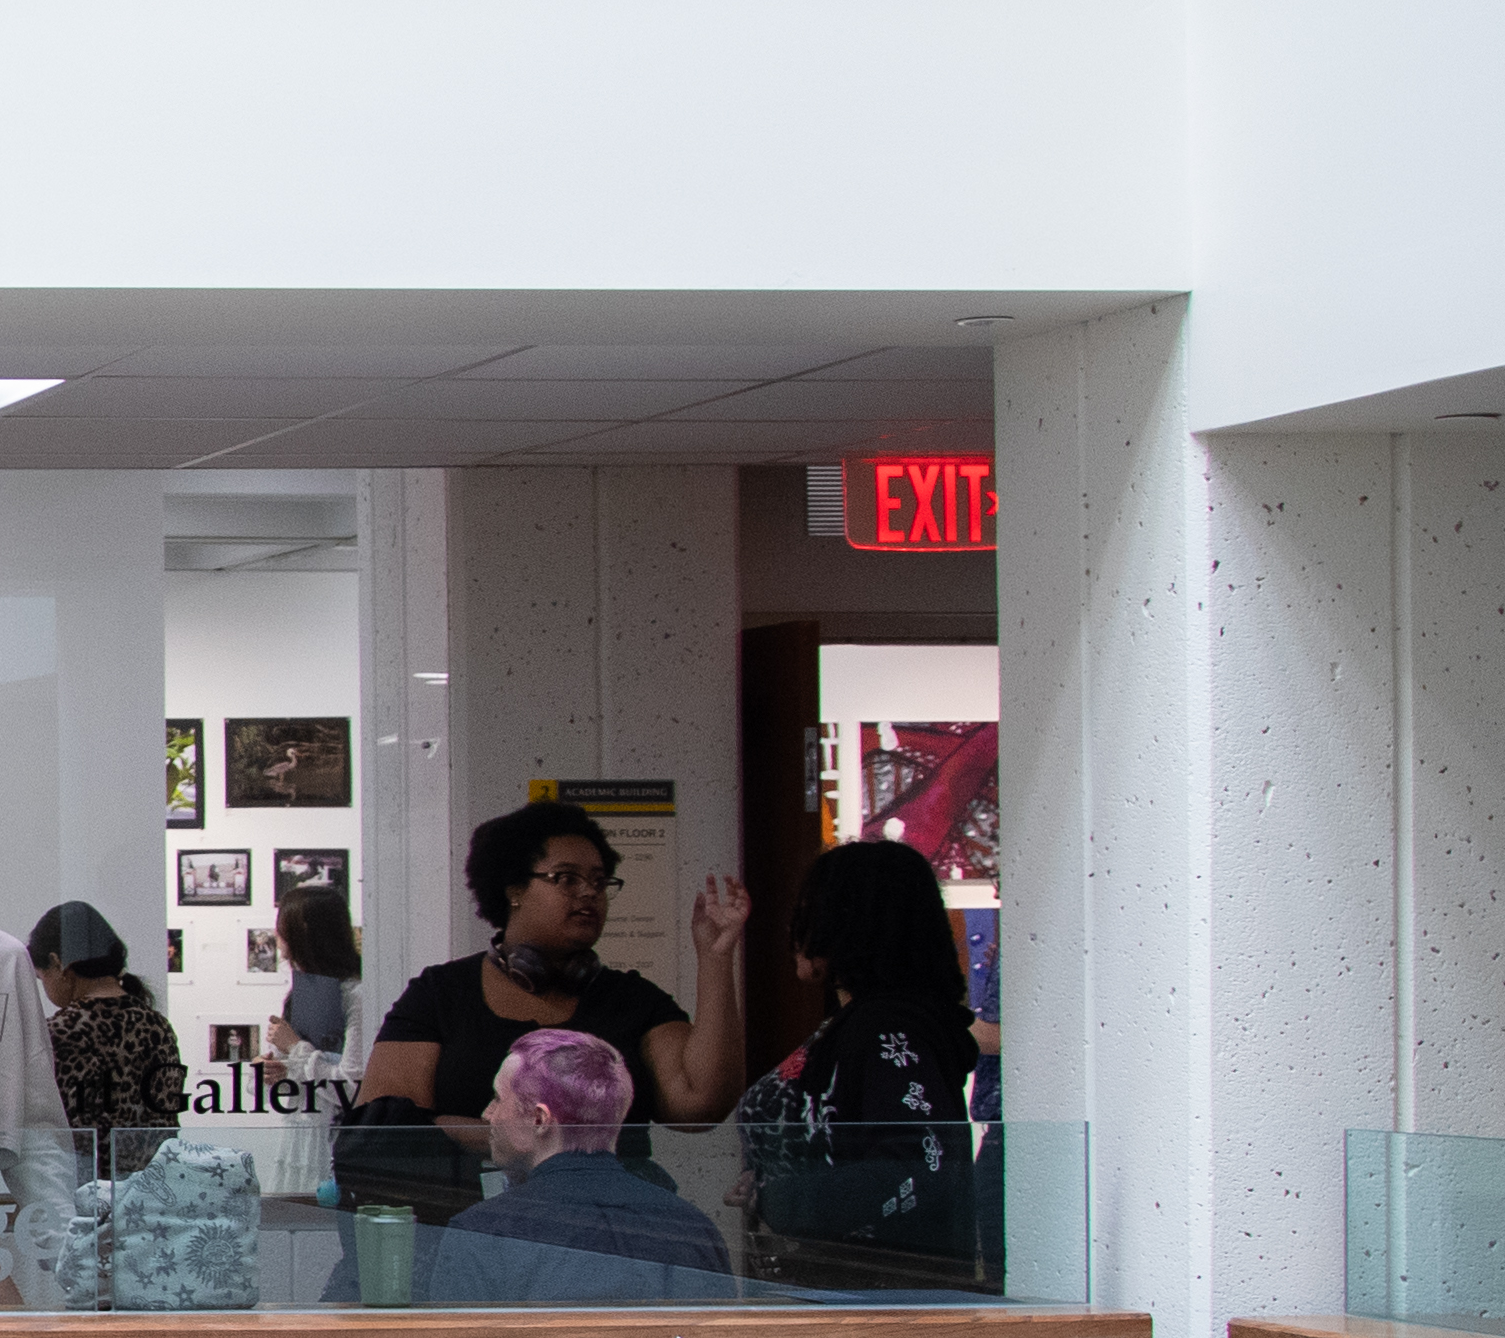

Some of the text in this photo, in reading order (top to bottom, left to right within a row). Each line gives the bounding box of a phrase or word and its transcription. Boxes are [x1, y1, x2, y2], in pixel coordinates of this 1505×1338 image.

[875, 464, 990, 542] EXIT
[565, 788, 668, 797] ACADEMIC BUILDING
[620, 829, 656, 838] FLOOR
[659, 829, 666, 838] 2
[141, 1061, 364, 1115] Gallery
